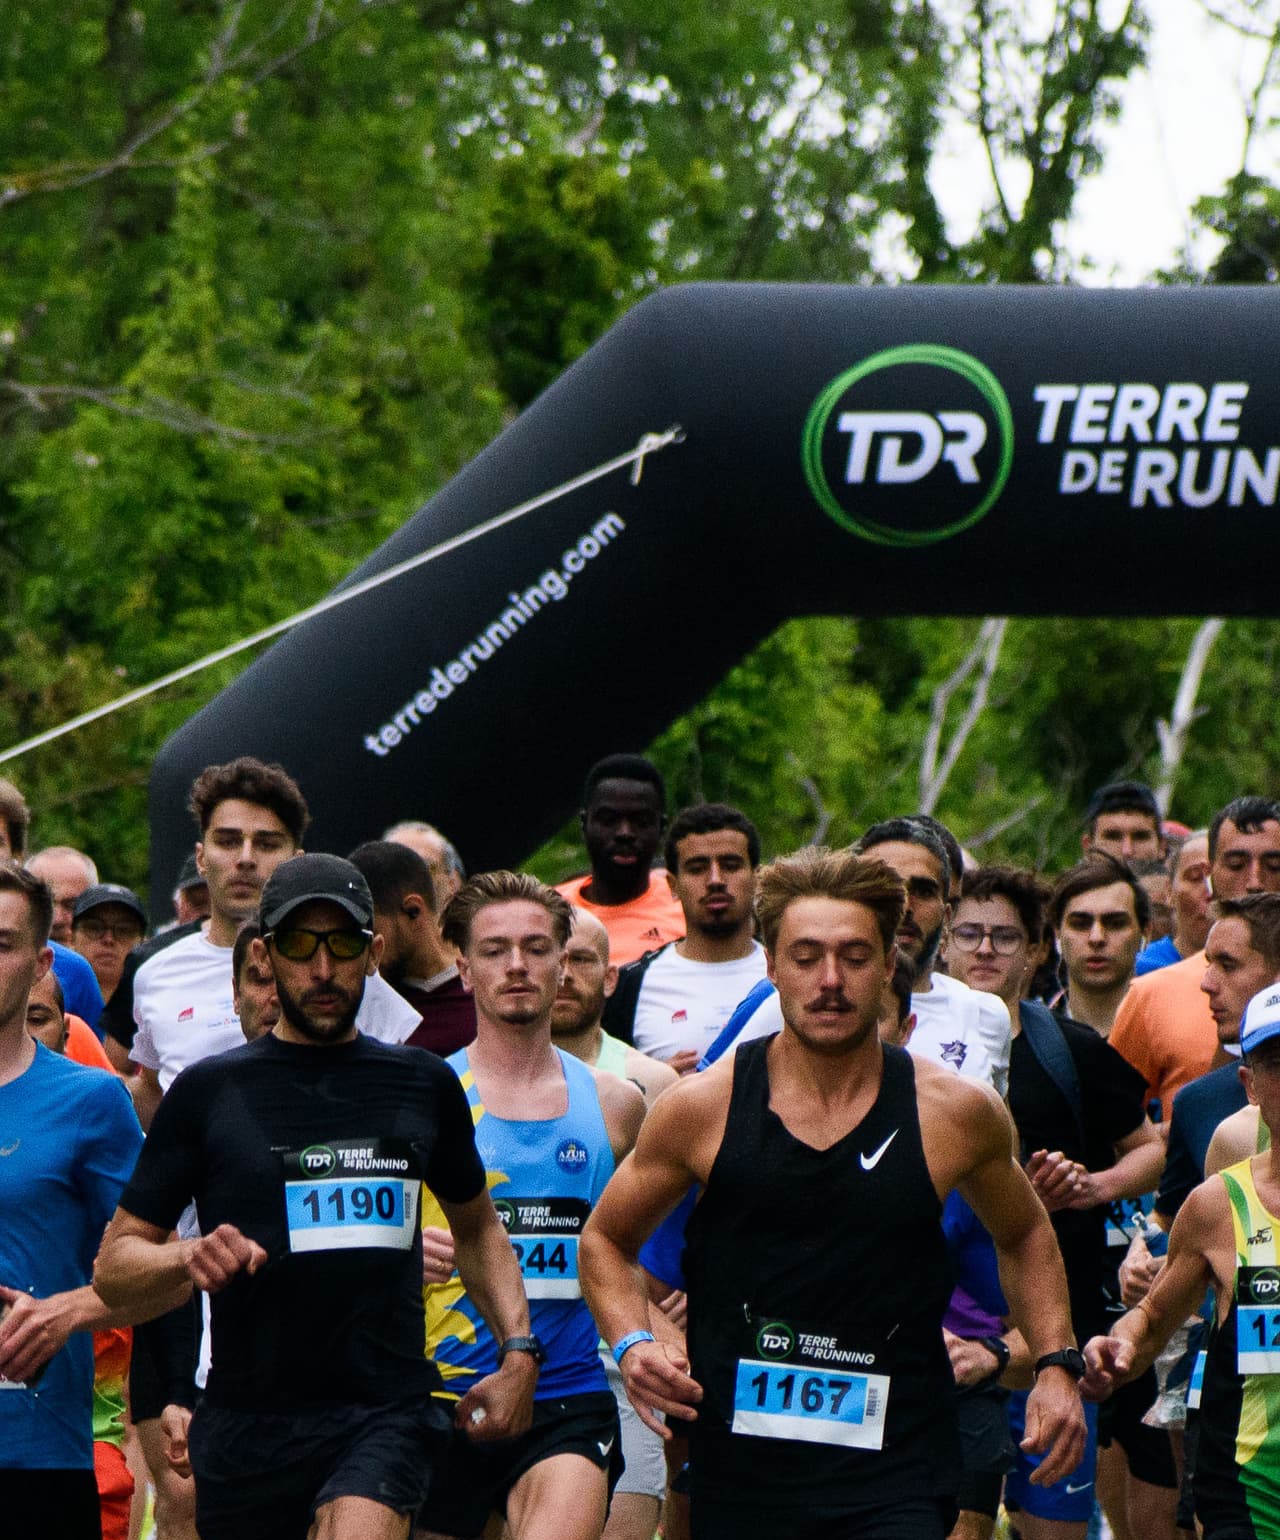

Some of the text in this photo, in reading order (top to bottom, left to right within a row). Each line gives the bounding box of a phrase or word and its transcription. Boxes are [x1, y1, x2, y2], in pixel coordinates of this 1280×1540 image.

[1033, 382, 1250, 443] TERRE
[838, 411, 988, 484] TDR
[1060, 450, 1128, 493] DE
[364, 512, 626, 756] terrederunning.com
[304, 1153, 332, 1168] TDR
[337, 1148, 375, 1160] TERRE
[343, 1159, 409, 1171] DE RUNNING
[302, 1186, 395, 1223] 1190
[517, 1206, 551, 1218] TERRE
[532, 1216, 580, 1230] RUNNING
[1254, 1280, 1280, 1294] TDR
[762, 1334, 790, 1350] TDR
[797, 1333, 839, 1349] TERRE
[801, 1346, 876, 1365] DE RUNNING
[751, 1371, 852, 1415] 1167
